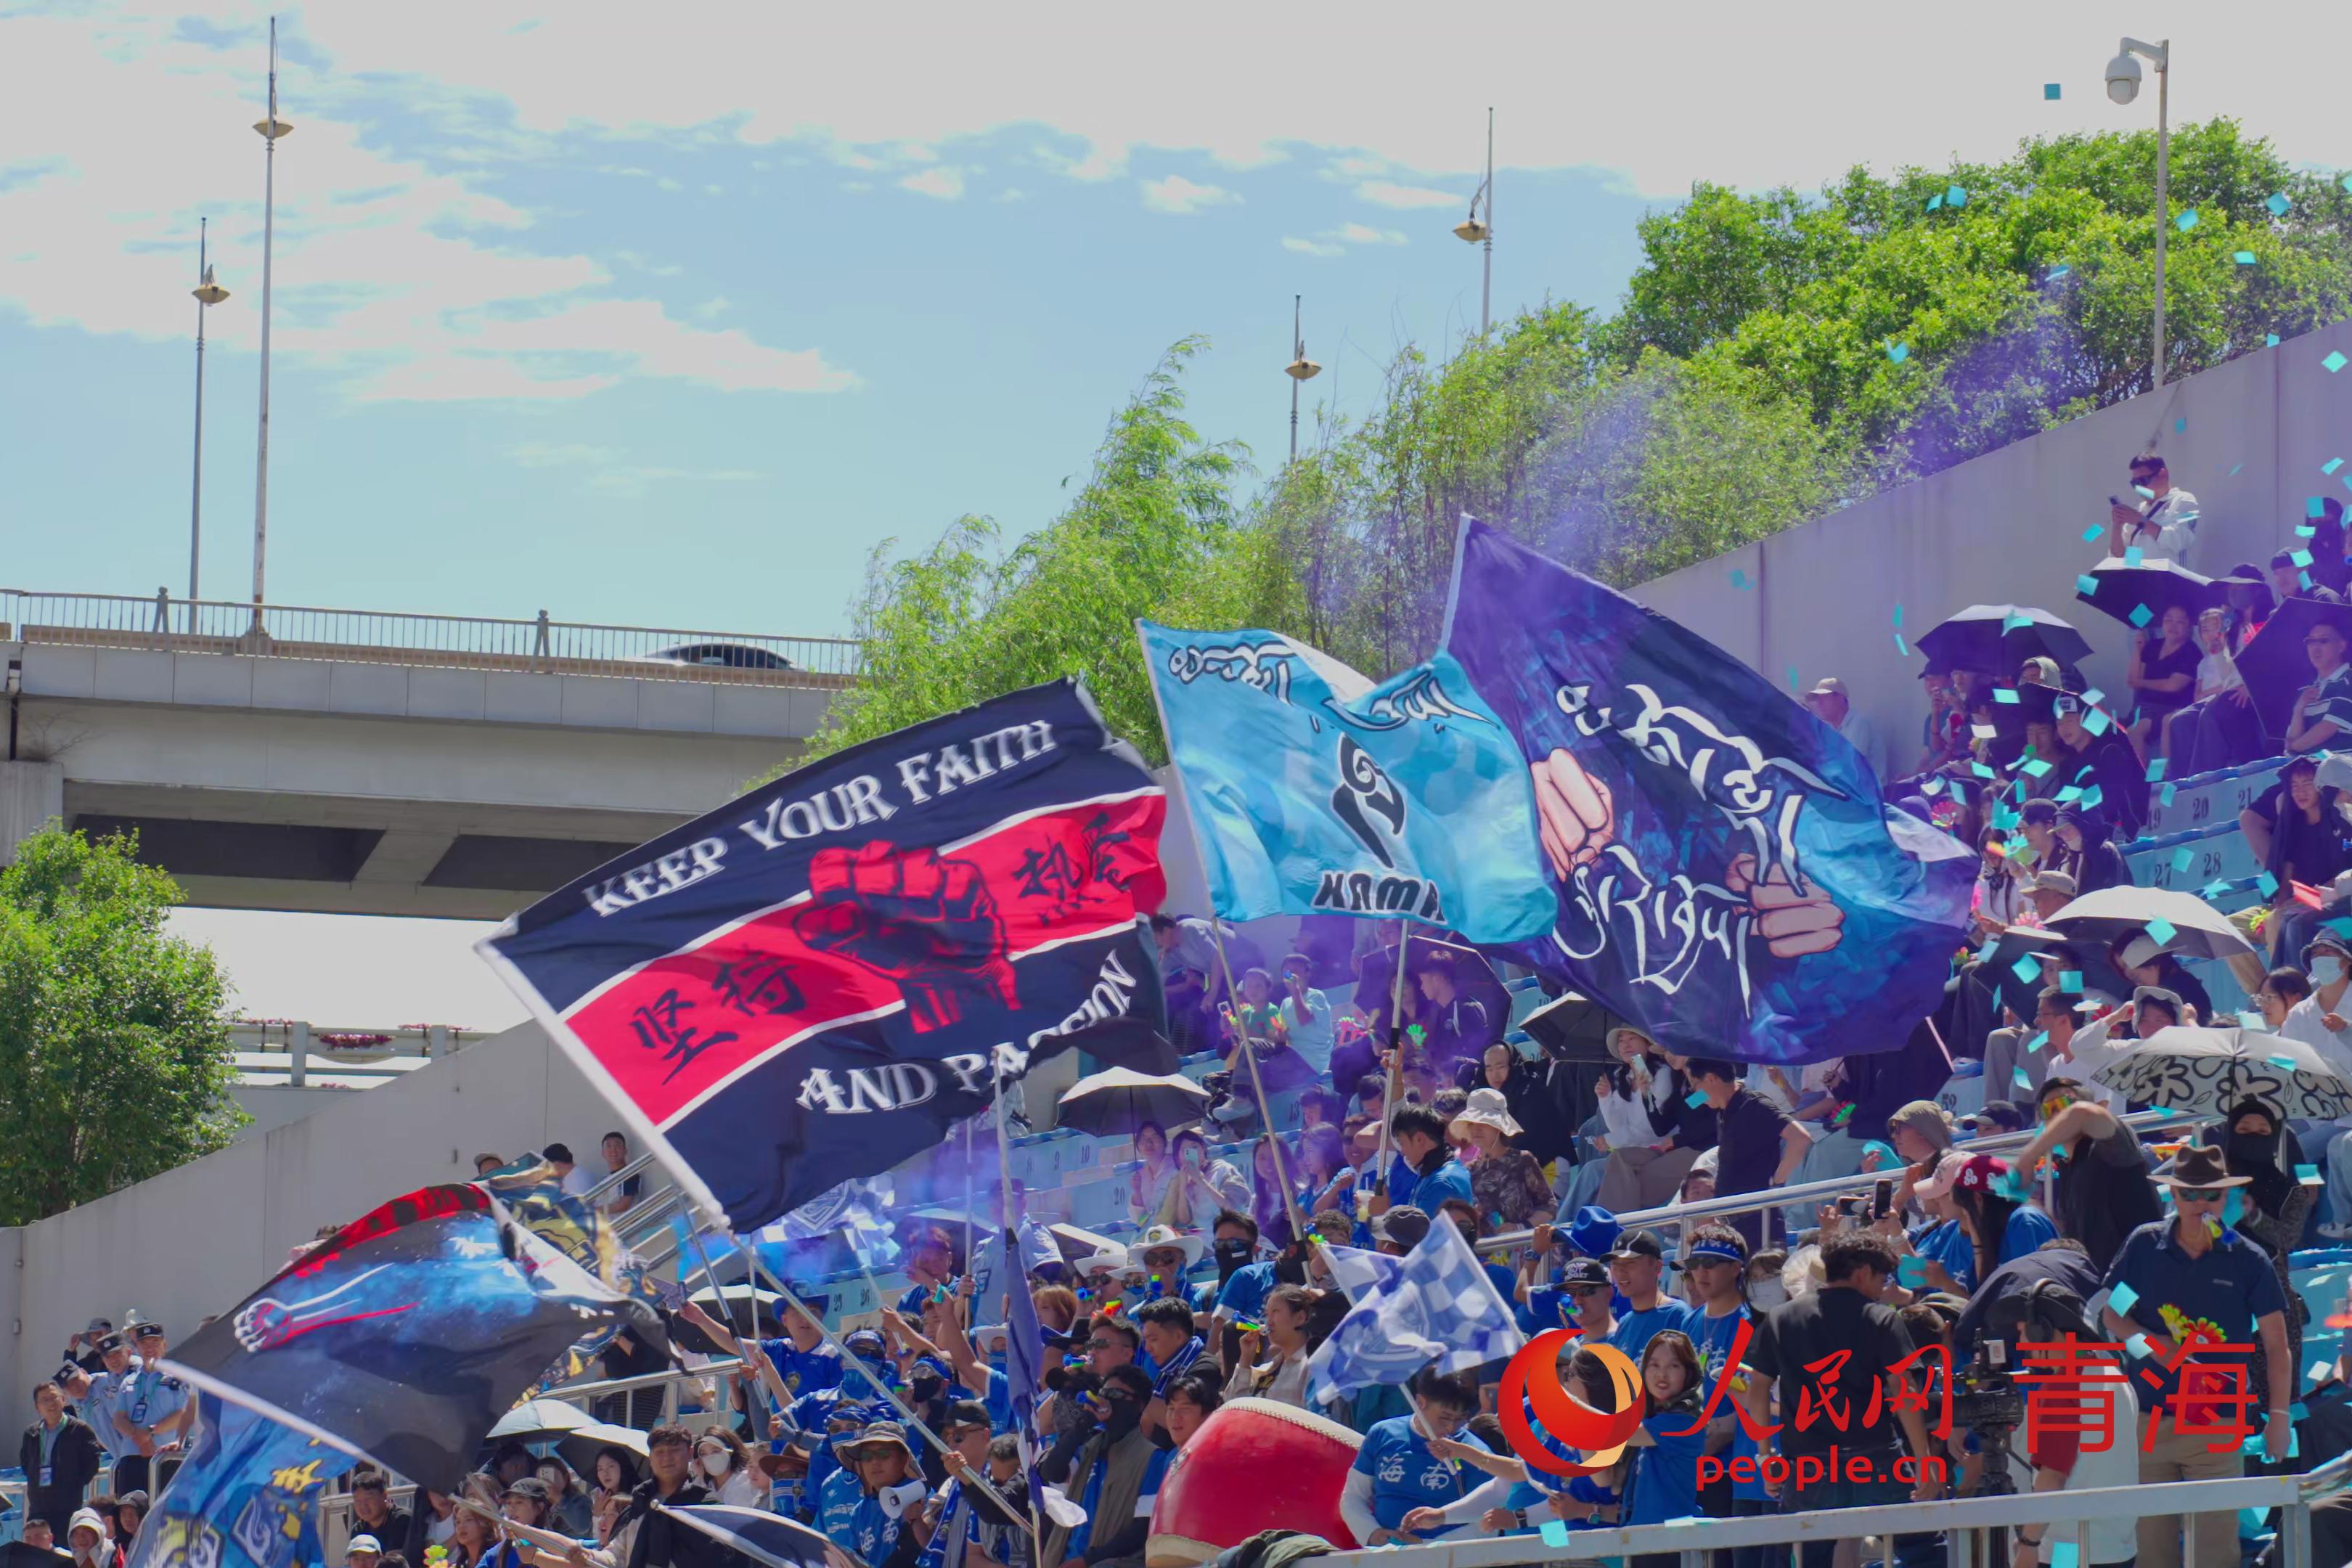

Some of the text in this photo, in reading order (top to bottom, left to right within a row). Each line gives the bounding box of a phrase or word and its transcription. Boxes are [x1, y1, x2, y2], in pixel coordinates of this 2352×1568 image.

[582, 719, 1058, 918] KEEP YOUR FAITH
[2147, 807, 2161, 831] 19
[2192, 797, 2210, 819] 20
[2155, 862, 2172, 886] 27
[2204, 852, 2222, 877] 28
[629, 944, 806, 1086] 坚持
[796, 1063, 939, 1114] AND
[1378, 1453, 1450, 1491] 海南
